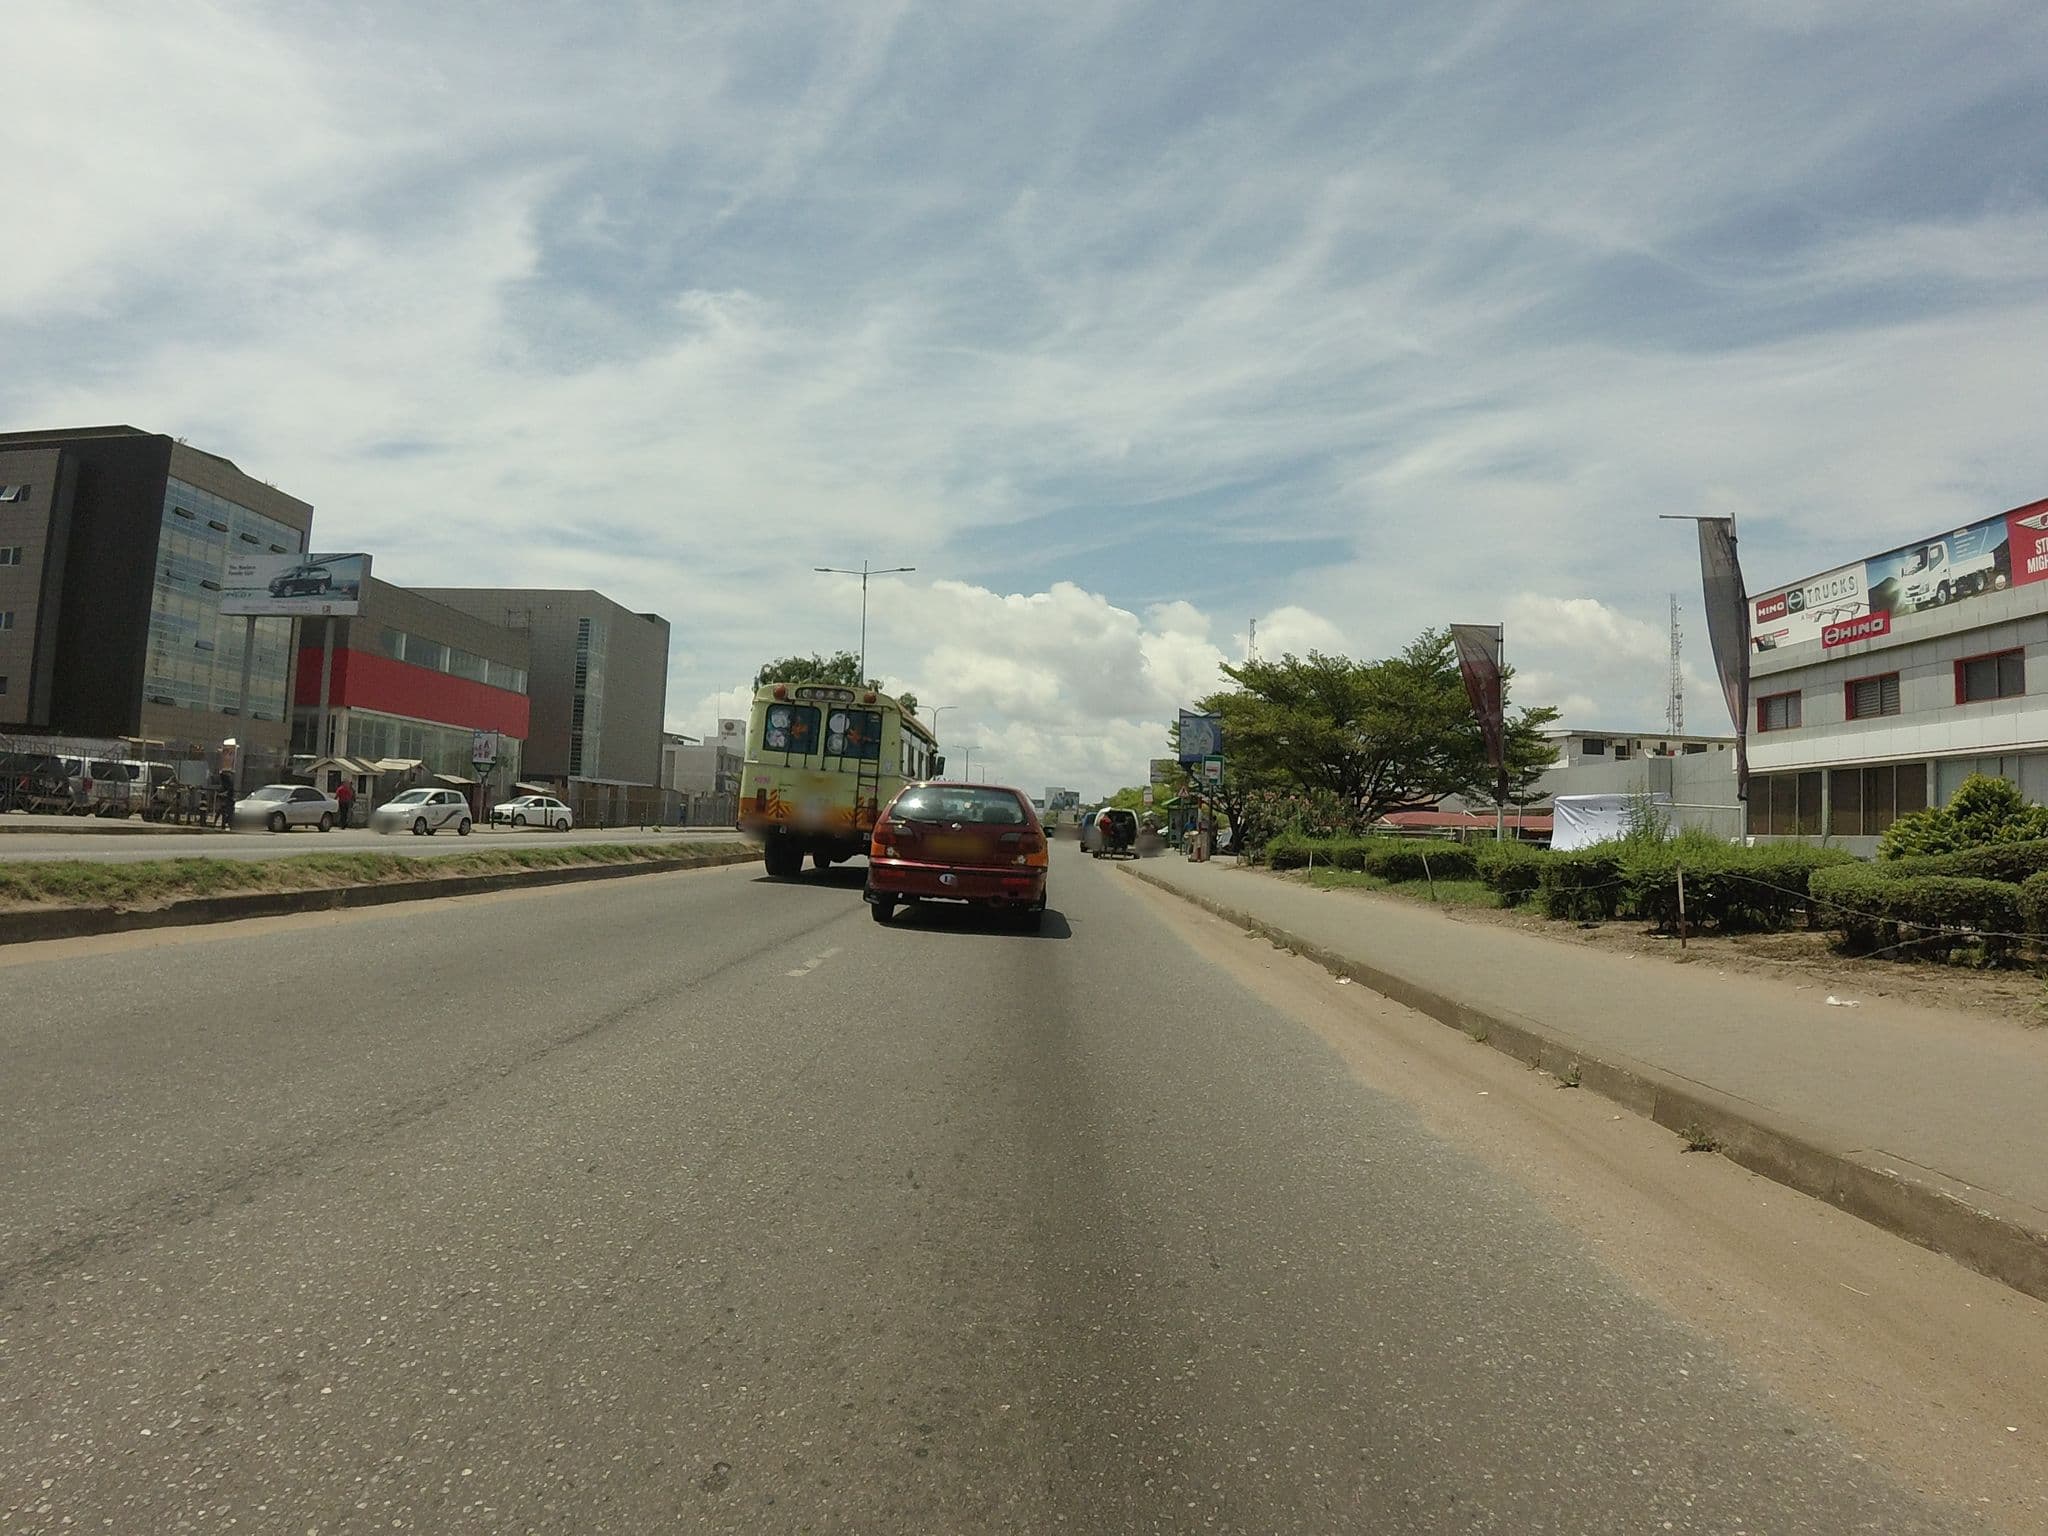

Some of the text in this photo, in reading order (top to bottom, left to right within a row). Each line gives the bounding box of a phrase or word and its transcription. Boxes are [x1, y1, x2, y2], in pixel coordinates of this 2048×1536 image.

[1758, 602, 1785, 617] HINO
[1807, 576, 1855, 603] TRUCKS
[1839, 618, 1883, 639] HINO
